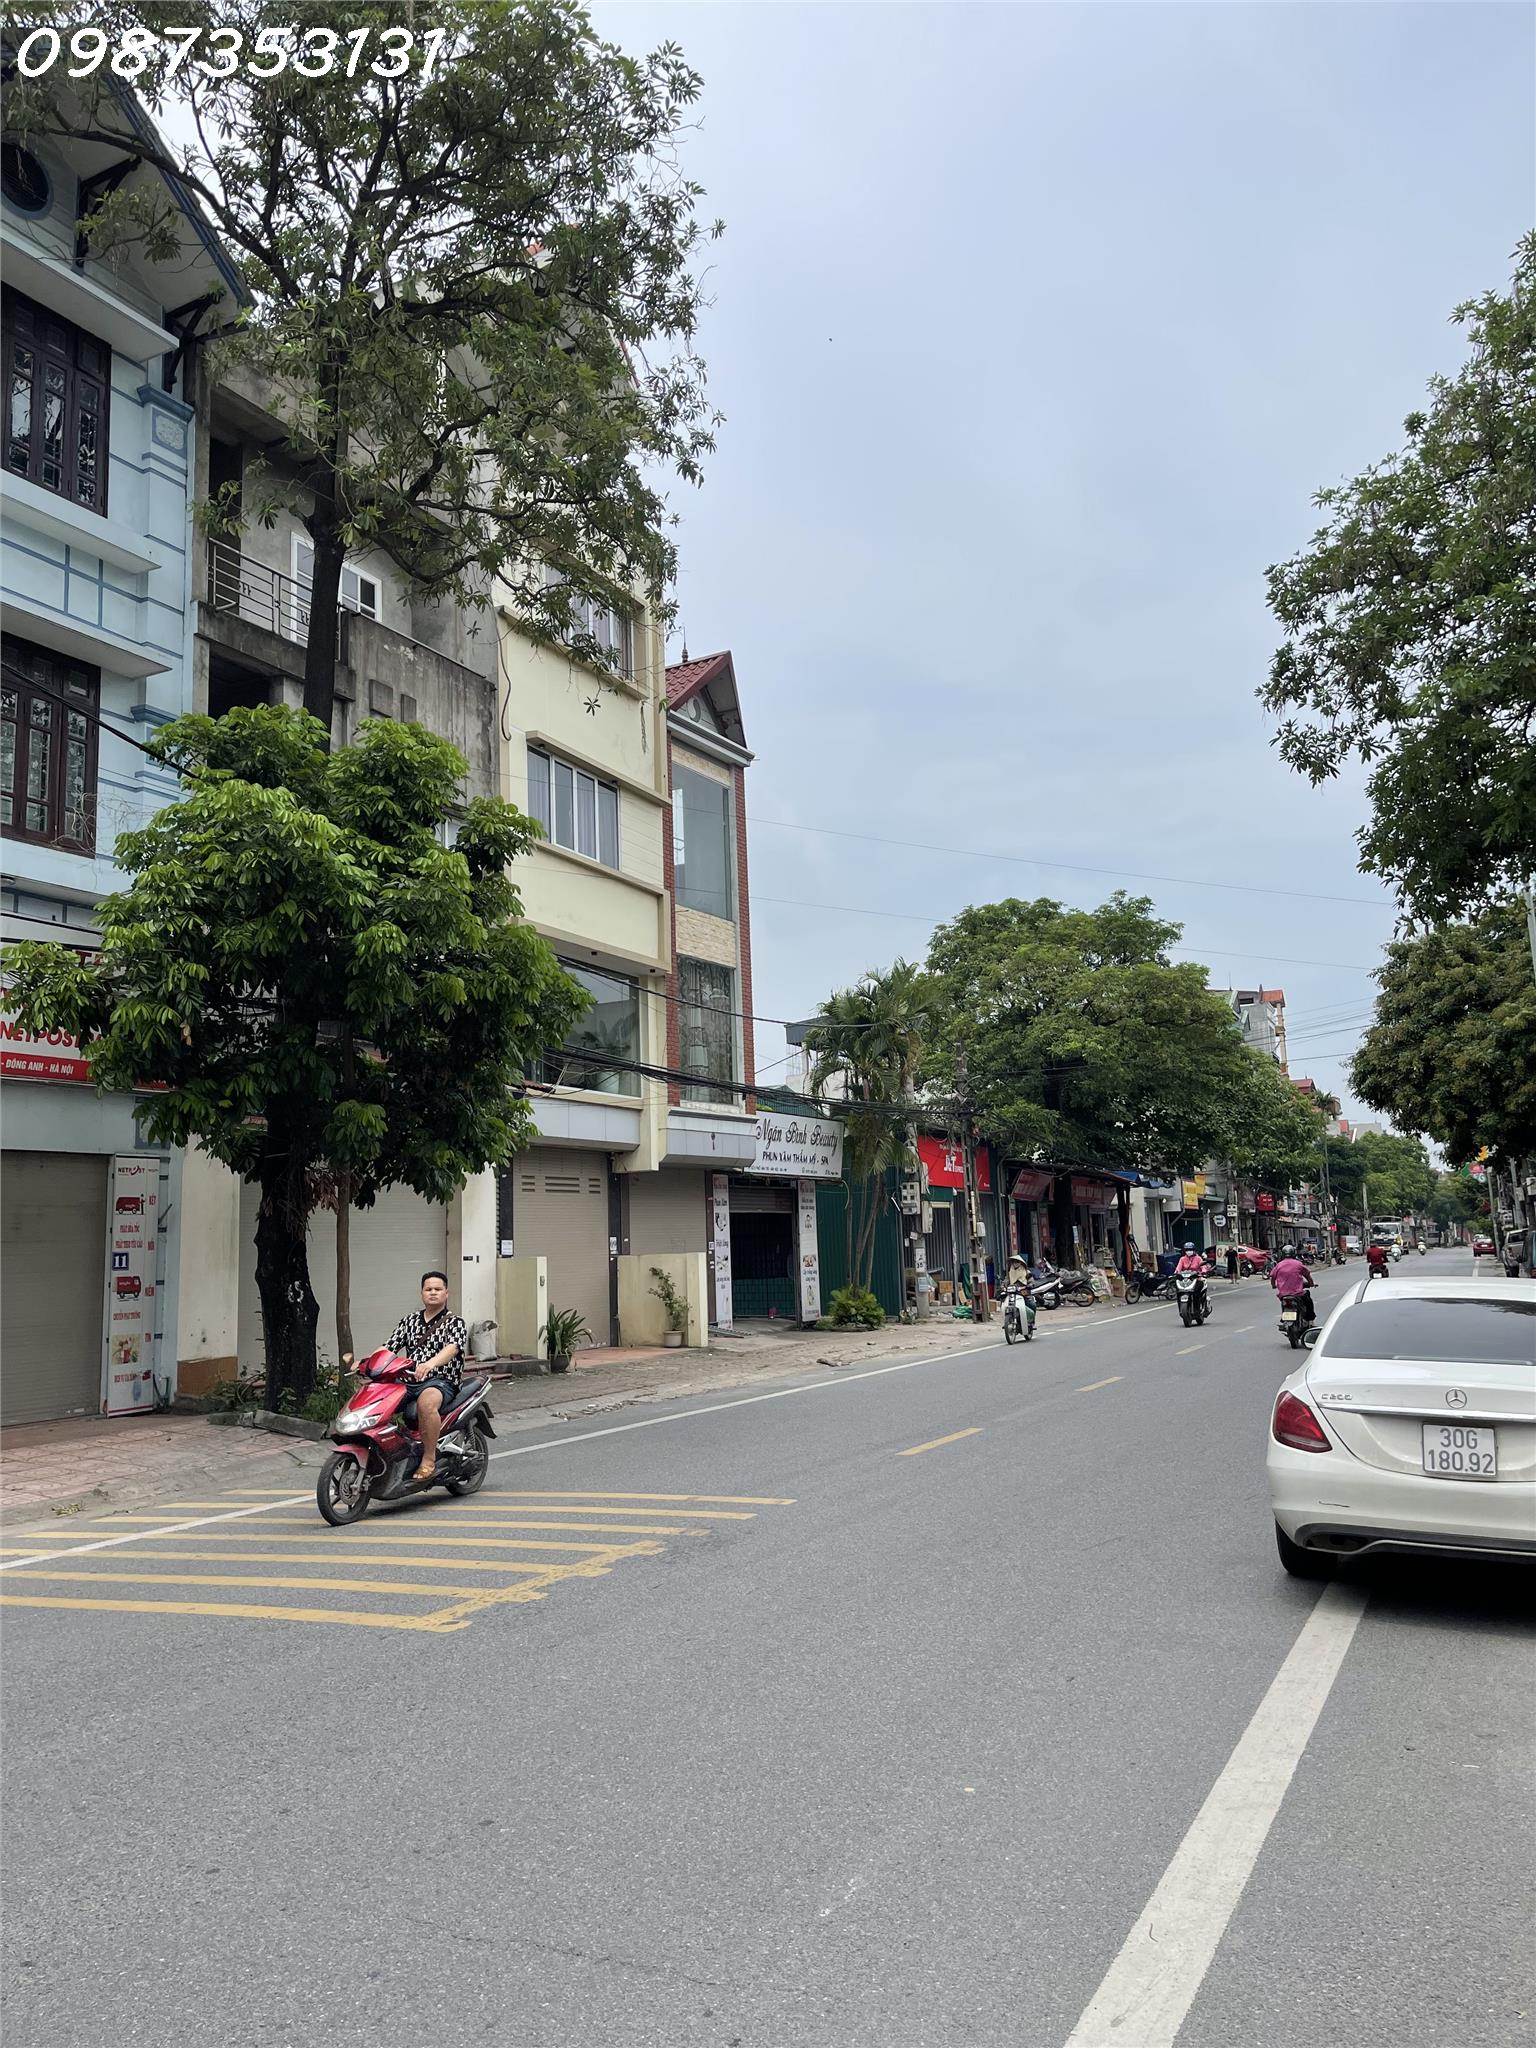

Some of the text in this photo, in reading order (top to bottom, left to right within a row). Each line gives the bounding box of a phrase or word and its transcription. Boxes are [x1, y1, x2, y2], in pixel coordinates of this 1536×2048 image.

[6, 1058, 27, 1070] ĐÔNG
[28, 1061, 44, 1072] ANH
[49, 1062, 59, 1073] HÀ
[61, 1063, 74, 1076] NỘI
[114, 1255, 127, 1268] 11
[1439, 1427, 1478, 1450] 30G
[1427, 1449, 1494, 1474] 180.92
